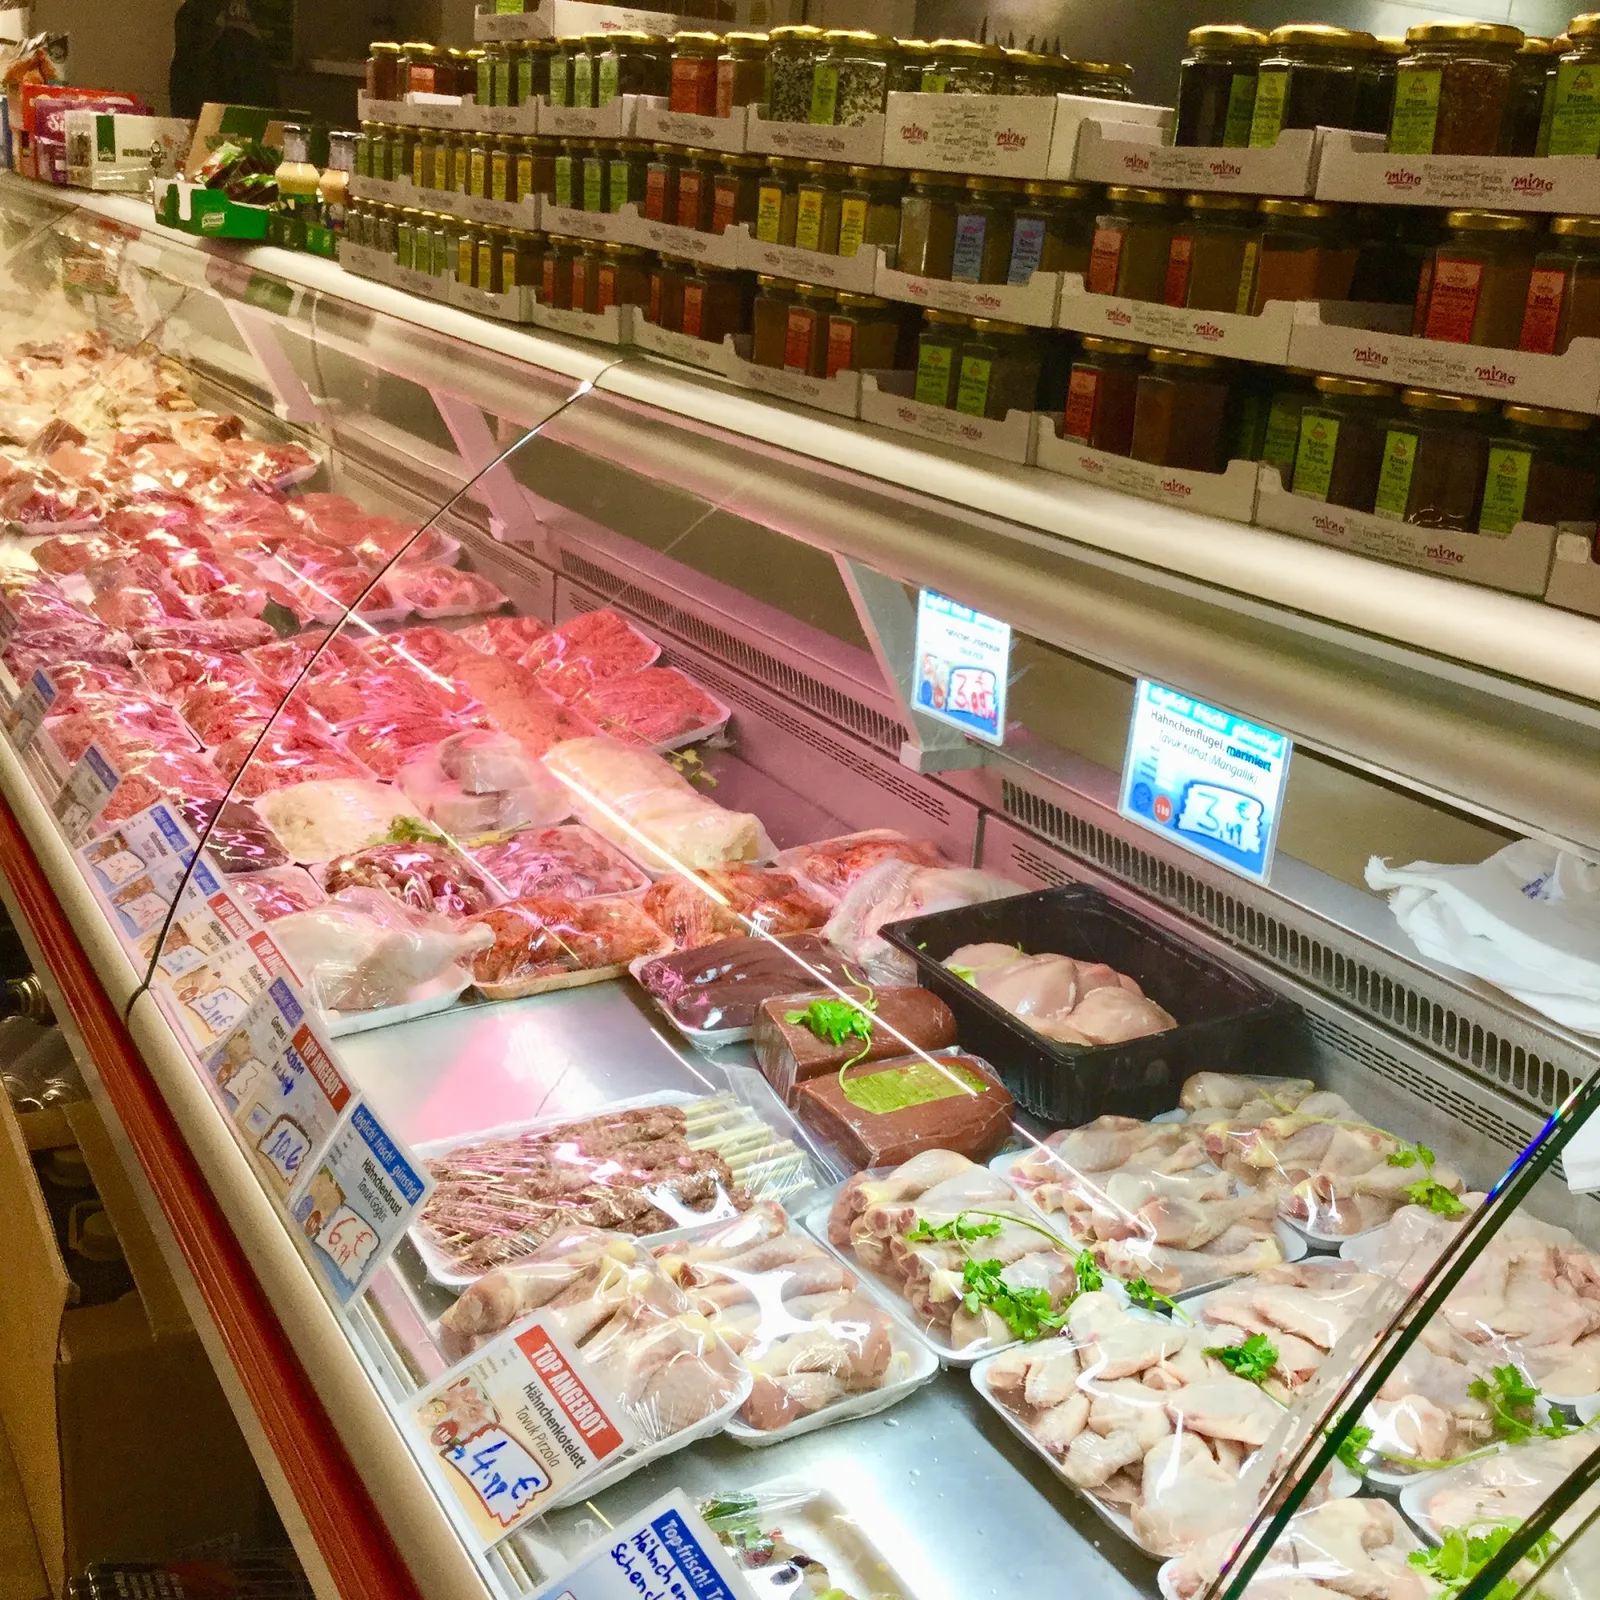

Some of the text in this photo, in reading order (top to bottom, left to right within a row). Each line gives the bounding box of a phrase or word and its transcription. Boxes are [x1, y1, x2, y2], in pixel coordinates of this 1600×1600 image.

[1384, 168, 1422, 186] mina
[1511, 173, 1554, 192] mina
[1353, 347, 1388, 366] mina
[1474, 366, 1516, 386] mina
[1312, 515, 1346, 536] mina
[1423, 544, 1465, 564] mina
[1226, 745, 1272, 773] mariniert
[255, 940, 273, 957] TOP
[299, 1037, 318, 1060] TOP
[310, 1054, 342, 1099] ANGEBOT
[352, 1111, 378, 1140] täglich!
[389, 1164, 421, 1200] günstig!
[356, 1178, 375, 1201] Tavuk
[361, 1158, 402, 1216] Hähnchenbrust
[531, 1342, 609, 1438] TOP ANGEBOT
[515, 1405, 561, 1468] Tavuk Pirzola
[523, 1381, 588, 1470] Hähnchenkotelett
[660, 1519, 715, 1588] Top-frisch!
